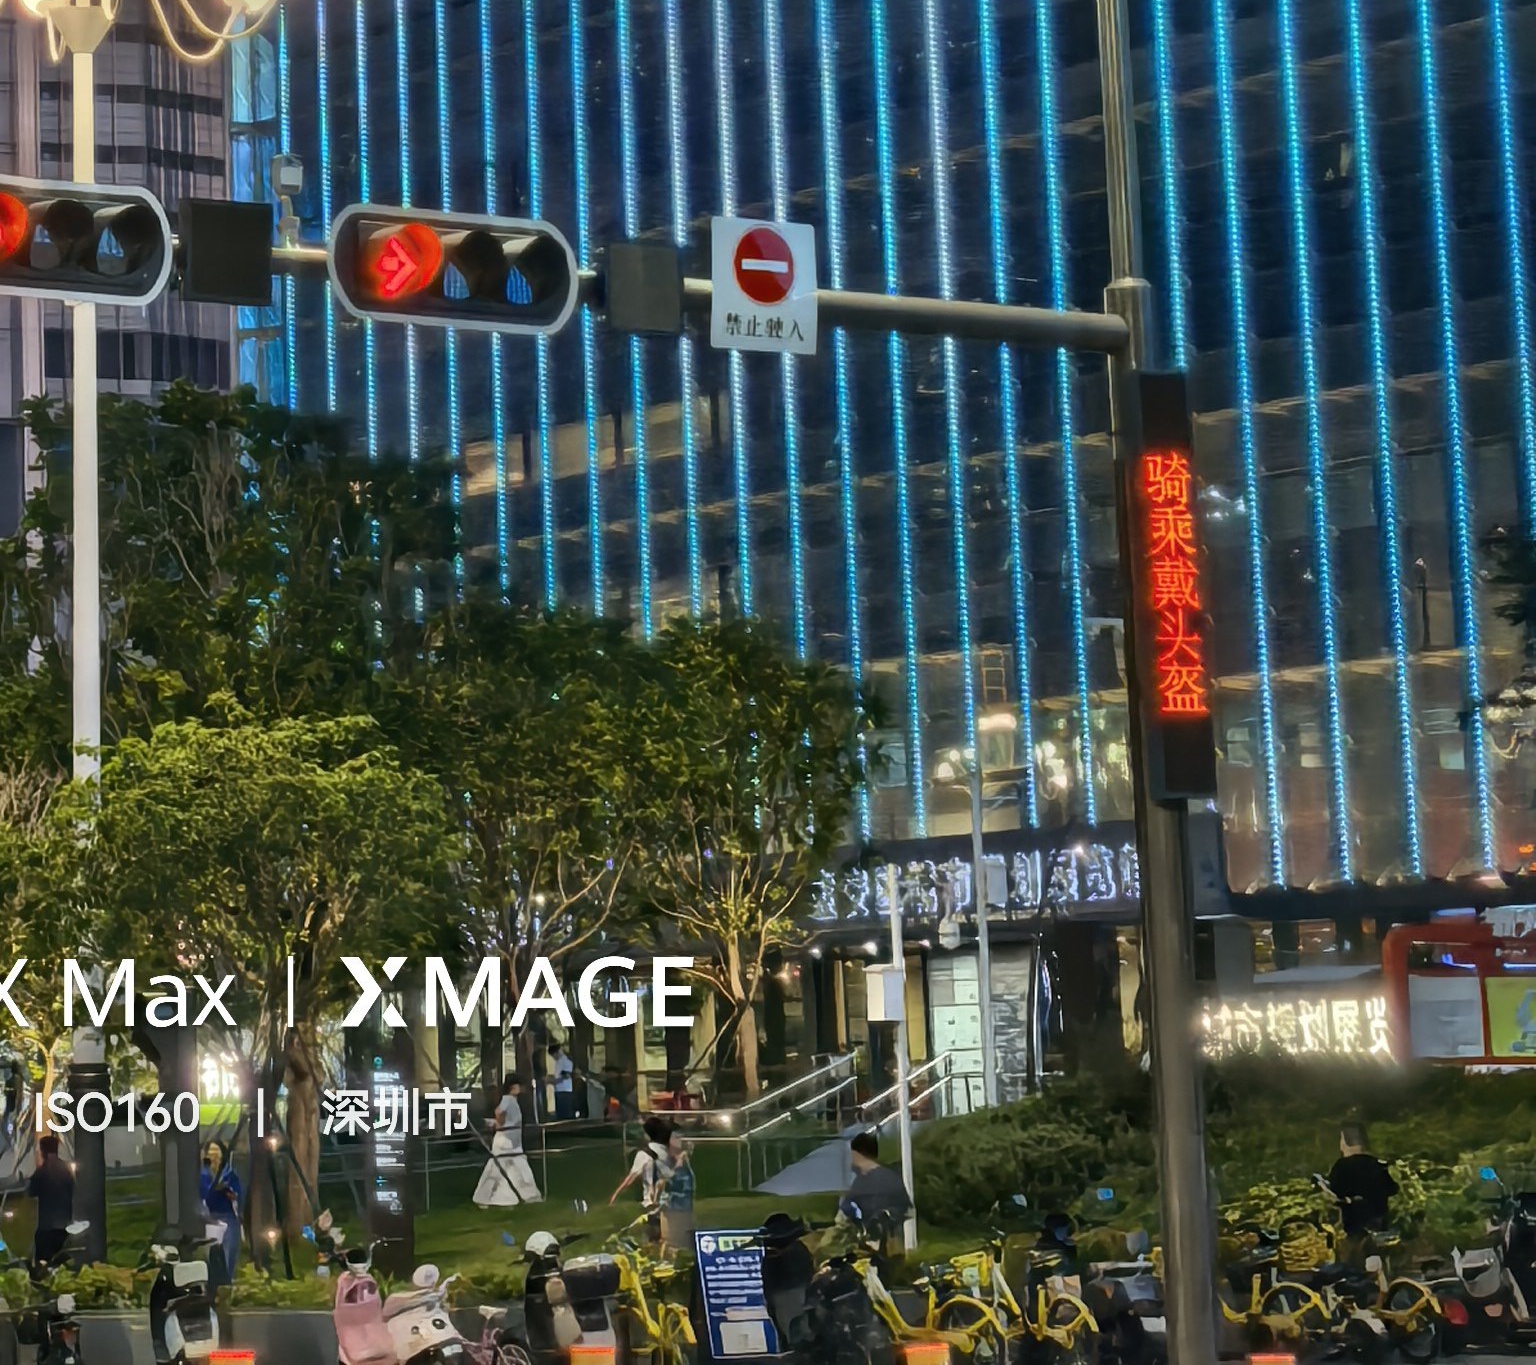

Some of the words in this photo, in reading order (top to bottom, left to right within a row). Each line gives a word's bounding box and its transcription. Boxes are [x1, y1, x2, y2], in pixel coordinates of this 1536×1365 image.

[1143, 450, 1209, 713] 骑乘戴头盔
